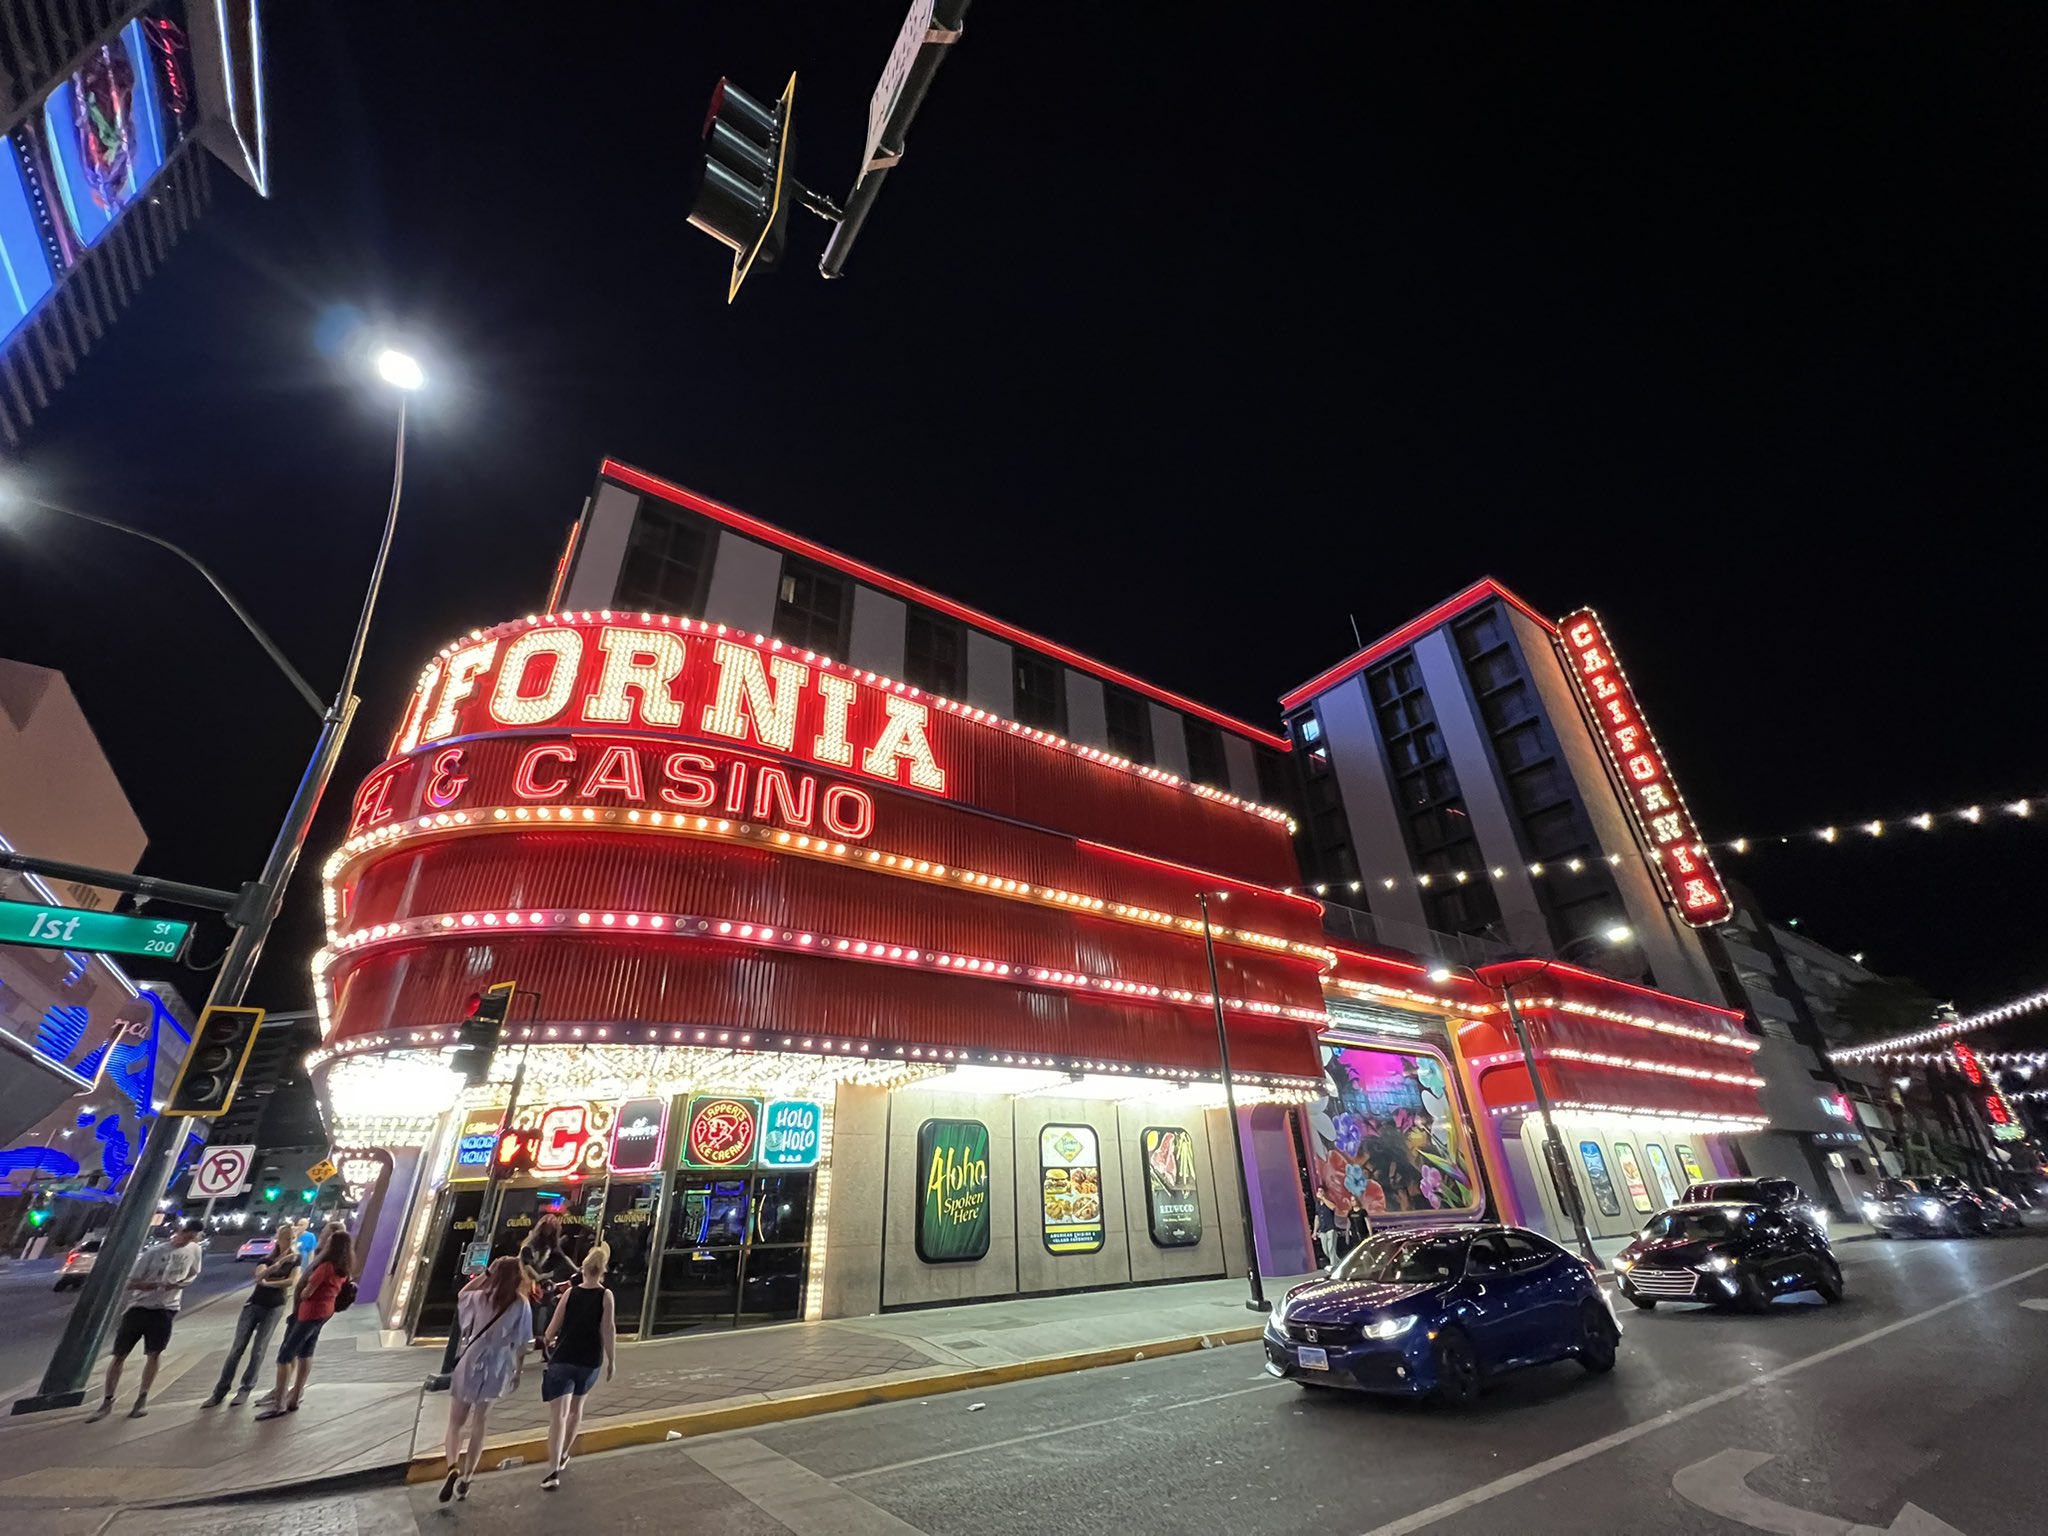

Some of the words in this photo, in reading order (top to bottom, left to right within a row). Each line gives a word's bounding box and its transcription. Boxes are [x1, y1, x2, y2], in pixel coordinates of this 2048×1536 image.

[1570, 622, 1717, 909] CALIFORNIA
[424, 747, 469, 808] &
[512, 745, 875, 839] CASINO
[28, 912, 80, 941] 1st
[153, 922, 170, 935] St
[144, 939, 175, 953] 200
[702, 1103, 748, 1121] LAPPERT'S
[775, 1107, 813, 1129] HOLO
[698, 1141, 712, 1157] ICE
[711, 1140, 745, 1160] CREAM
[781, 1129, 815, 1151] HOLO
[926, 1145, 987, 1227] Aloha
[944, 1191, 985, 1217] Spoken
[953, 1206, 979, 1225] Here
